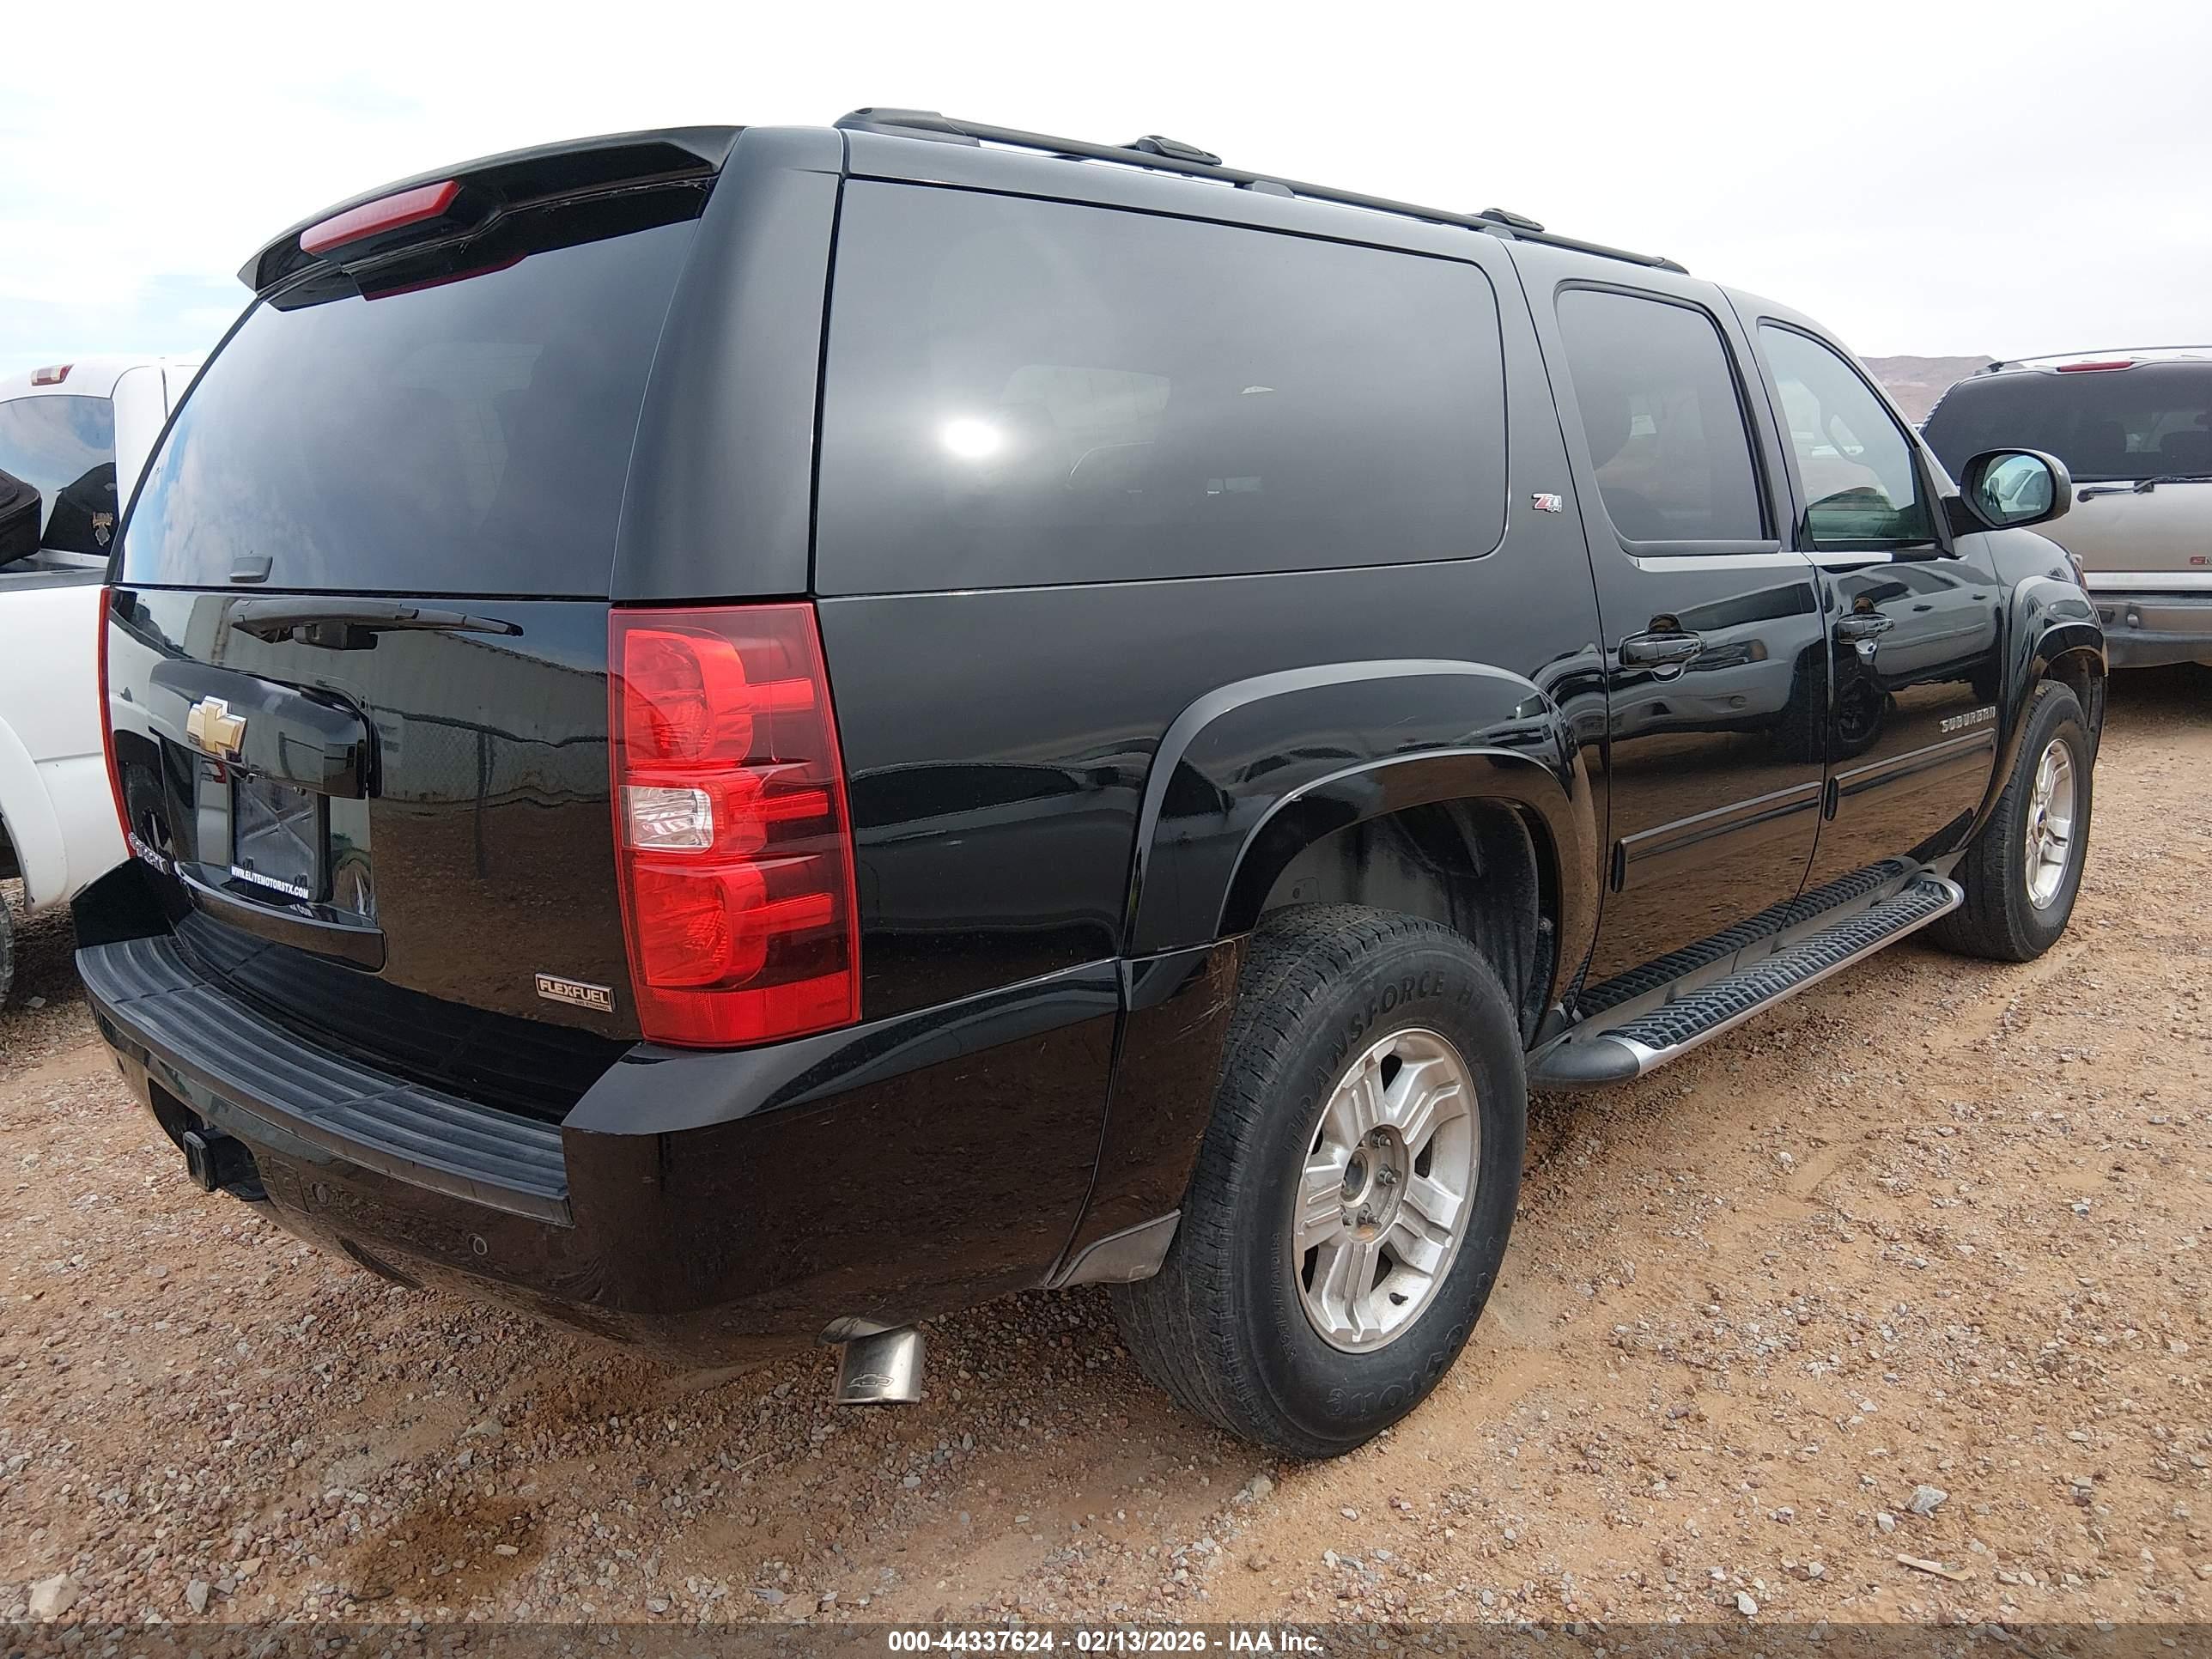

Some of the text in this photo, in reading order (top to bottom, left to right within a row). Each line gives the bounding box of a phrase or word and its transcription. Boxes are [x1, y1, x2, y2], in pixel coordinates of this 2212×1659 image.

[1939, 705, 1996, 733] SUBURBAN
[231, 865, 309, 899] WWW.ELITEMOTORSTX.COM
[539, 979, 610, 1004] FLEXFUEL
